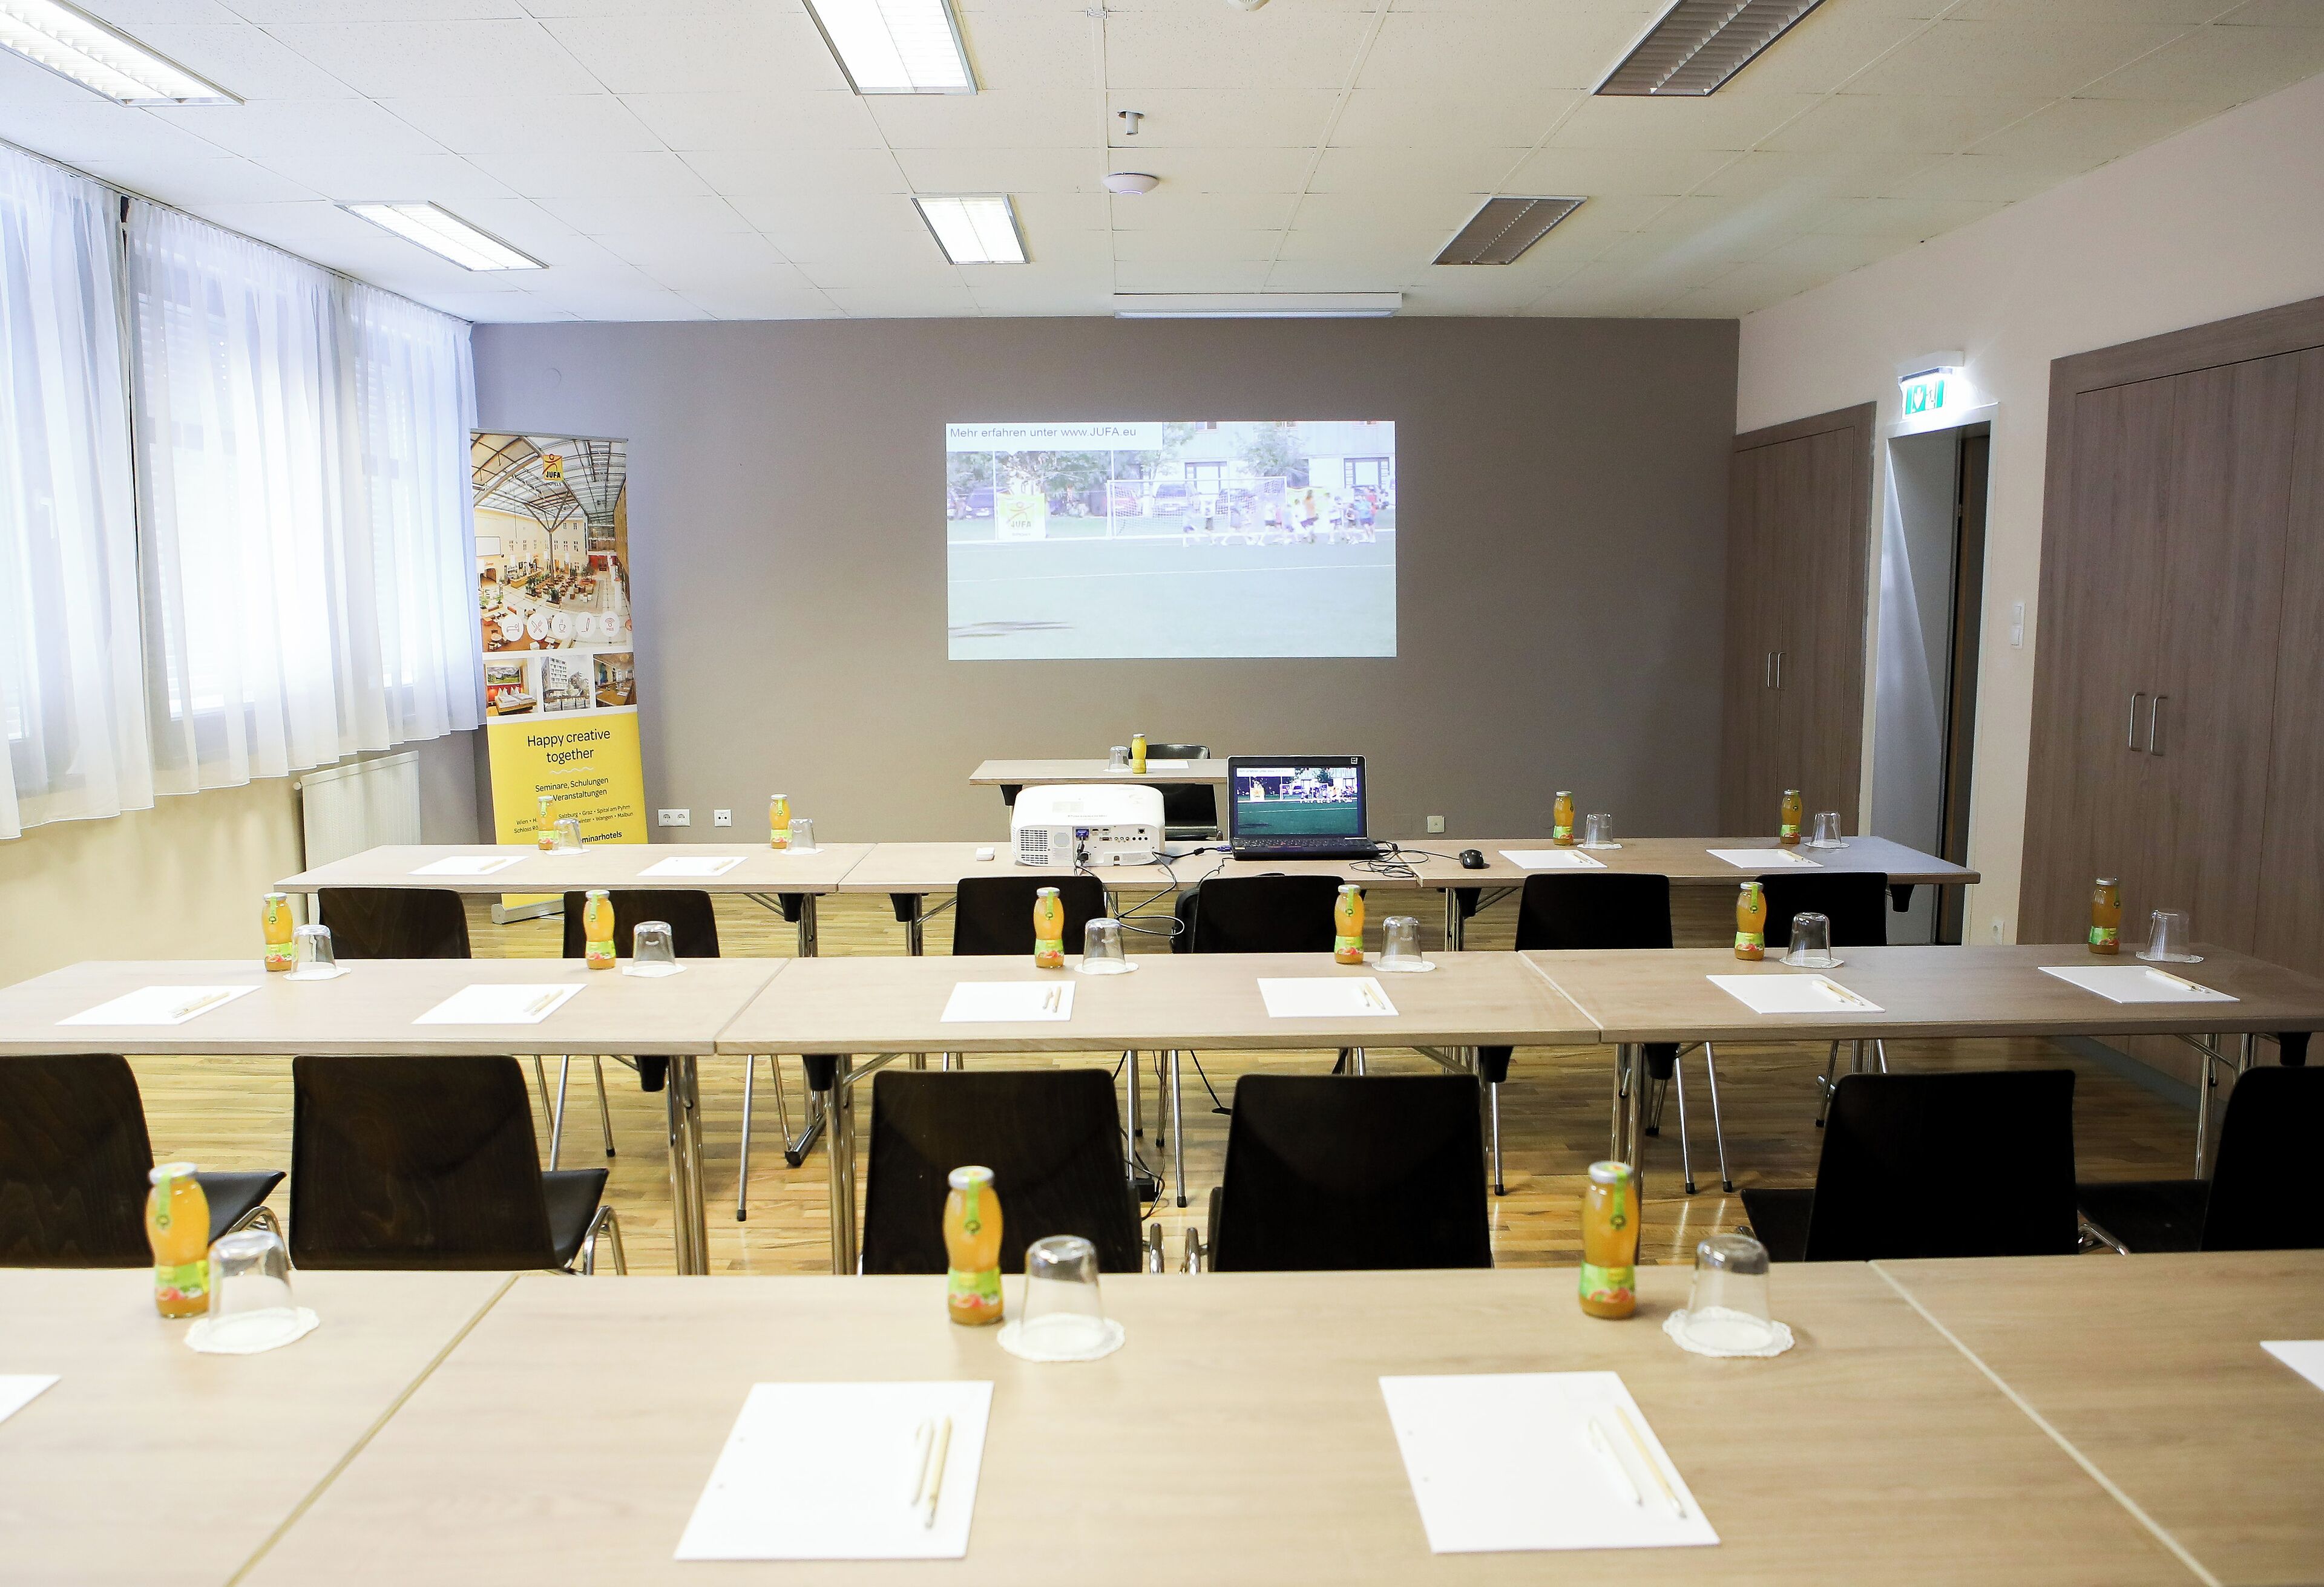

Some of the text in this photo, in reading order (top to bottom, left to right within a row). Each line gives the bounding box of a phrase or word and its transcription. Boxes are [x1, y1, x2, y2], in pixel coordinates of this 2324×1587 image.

[950, 427, 1137, 437] Mehr erfahren unter www.JUFA.eu
[527, 728, 611, 748] Happy creative
[546, 748, 594, 765] together
[535, 777, 609, 793] Seminare, Schulungen
[553, 789, 608, 802] Veranstaltungen
[581, 831, 622, 843] minarhotels
